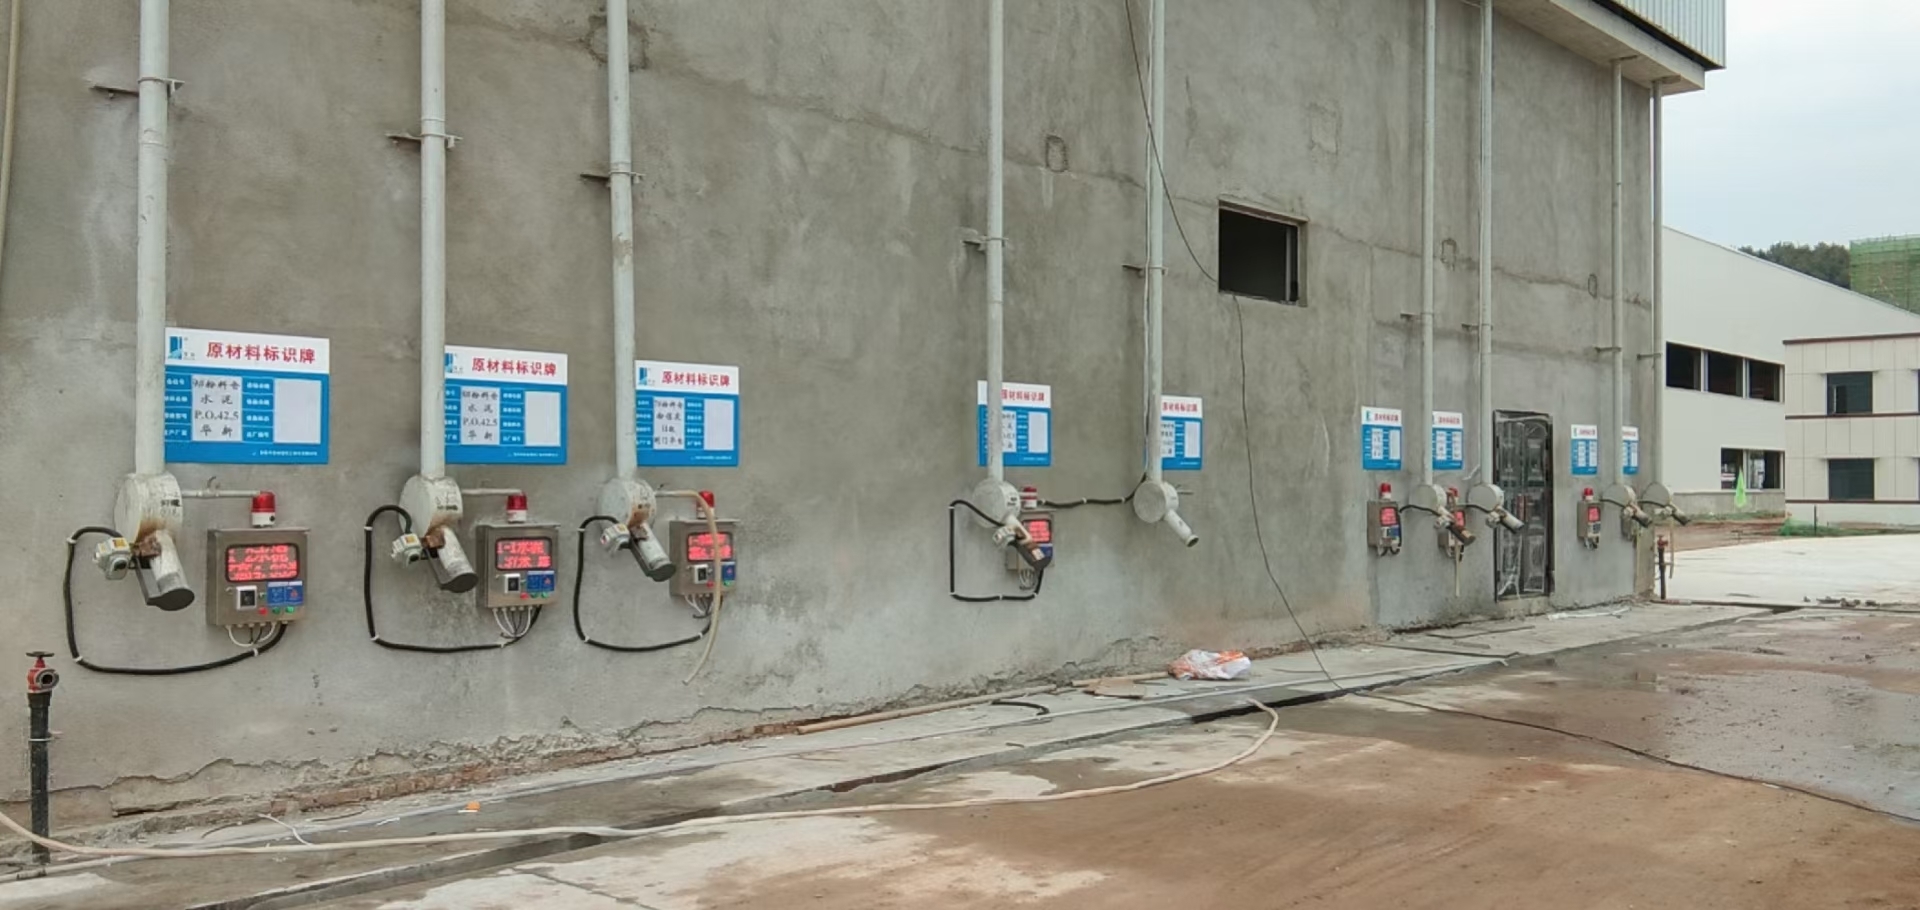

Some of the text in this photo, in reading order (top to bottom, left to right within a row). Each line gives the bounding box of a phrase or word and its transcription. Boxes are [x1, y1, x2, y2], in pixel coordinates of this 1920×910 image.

[206, 341, 316, 364] 原材料标识牌
[472, 357, 557, 376] 原材料标识牌
[661, 371, 730, 387] 原材料标识牌
[200, 394, 233, 405] 水泥
